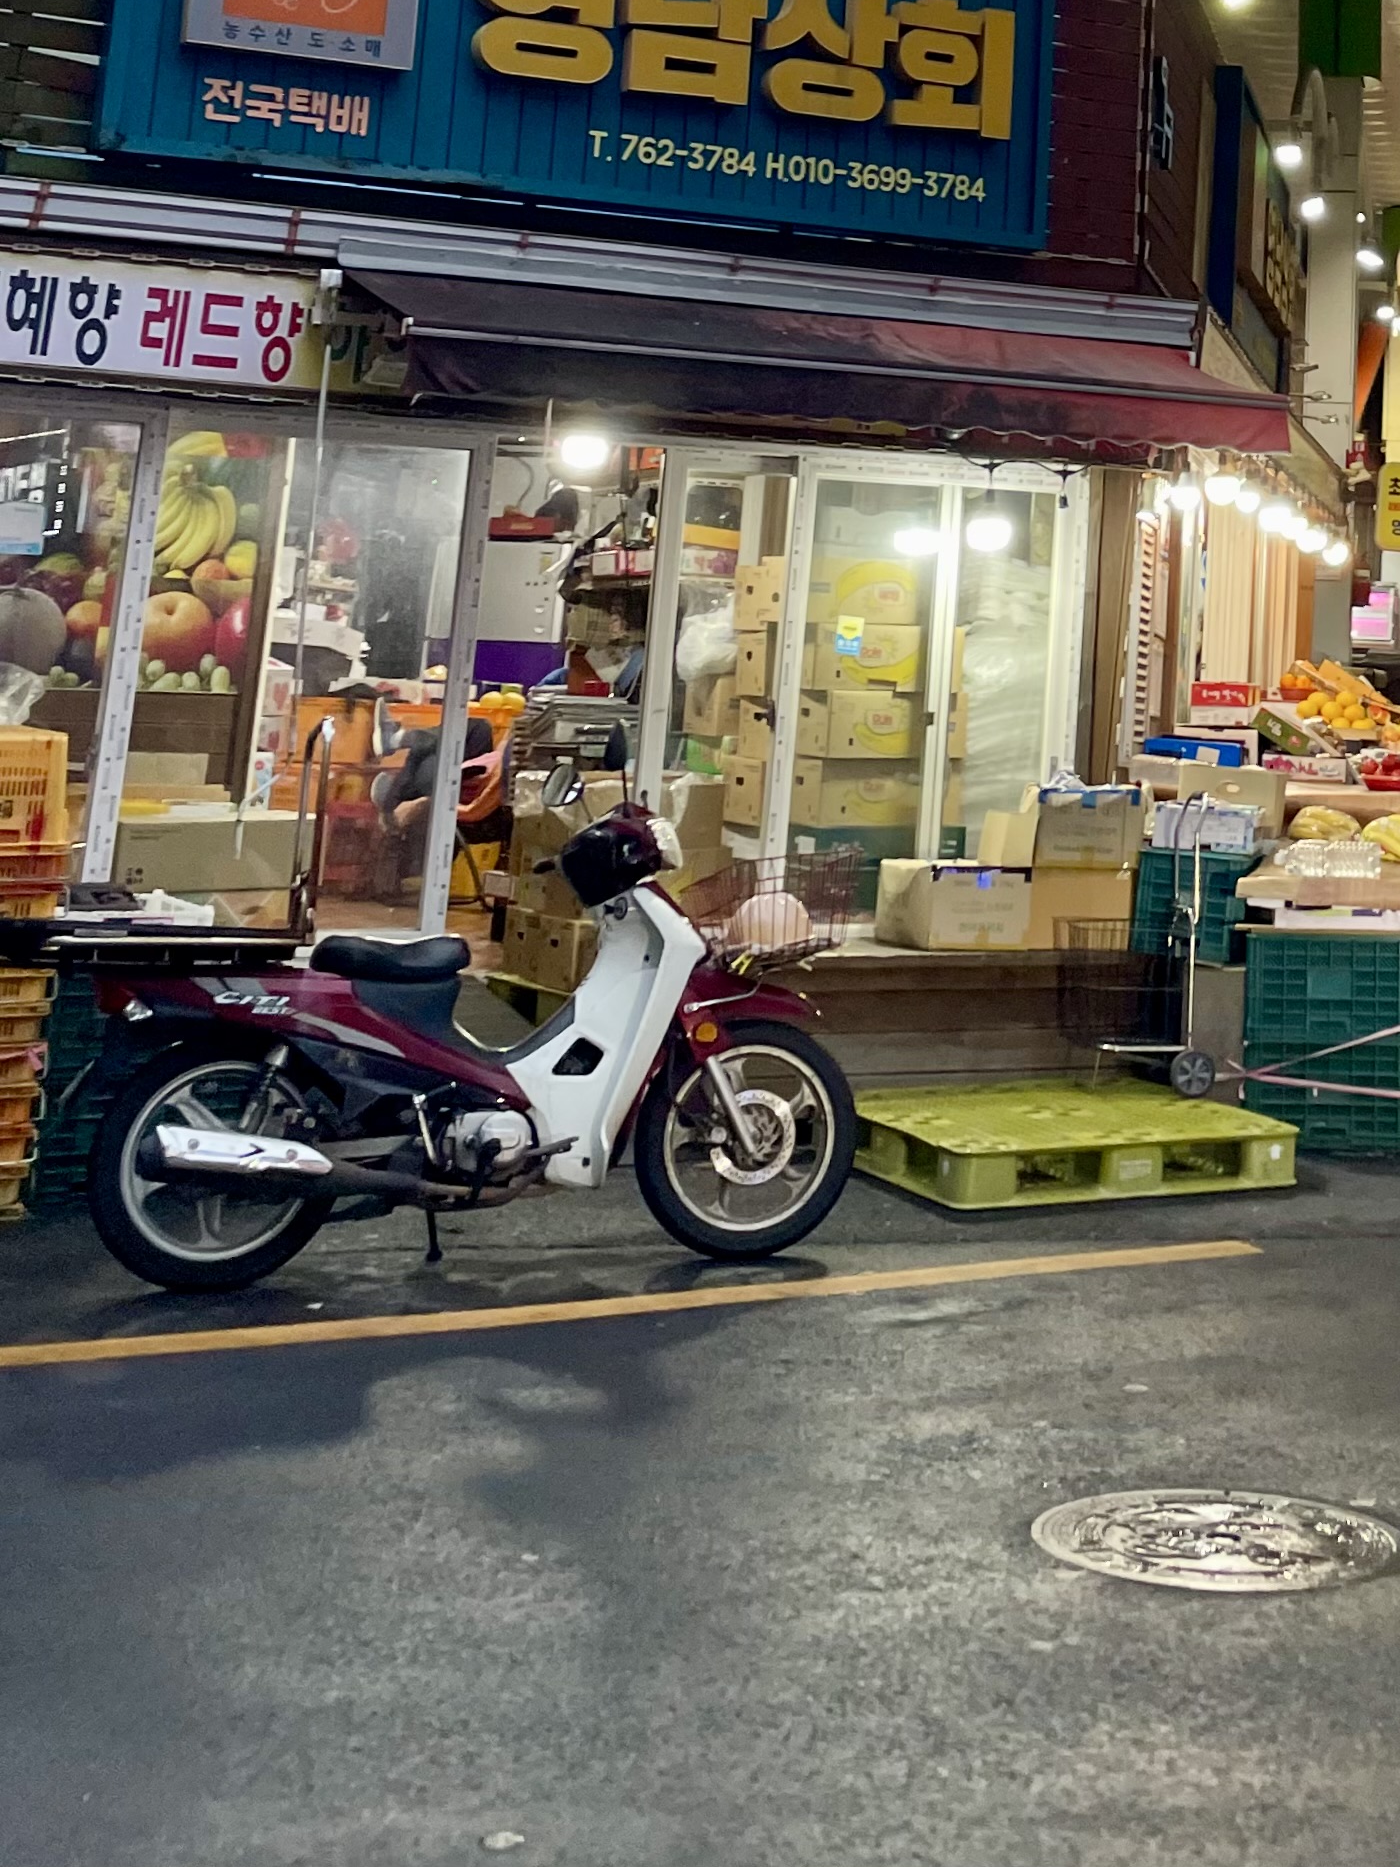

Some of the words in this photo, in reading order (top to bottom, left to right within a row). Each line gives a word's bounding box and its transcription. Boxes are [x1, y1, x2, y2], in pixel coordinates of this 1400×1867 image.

[202, 77, 370, 137] 전국택배
[140, 287, 304, 382] 레드향
[214, 991, 290, 1006] CITI
